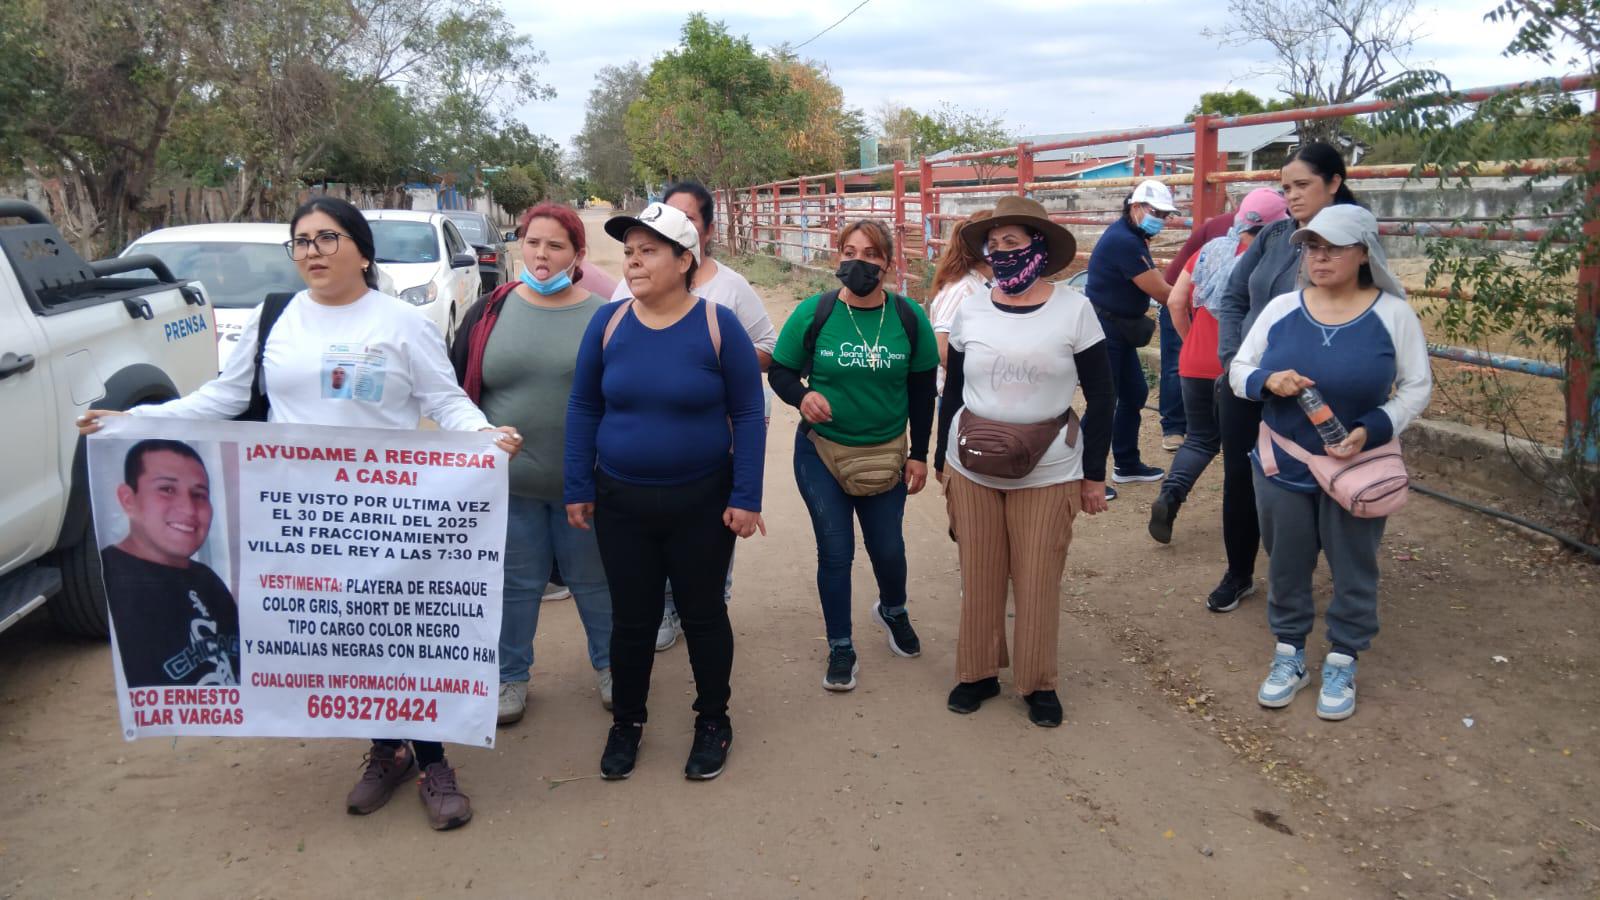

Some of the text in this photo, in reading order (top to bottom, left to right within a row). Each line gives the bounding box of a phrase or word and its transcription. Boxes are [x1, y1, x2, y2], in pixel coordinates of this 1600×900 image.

[164, 314, 207, 342] PRENSA
[246, 444, 495, 469] ¡AYUDAME A REGRESAR
[335, 467, 418, 486] A CASA!
[260, 491, 491, 513] FUE VISTO POR ULTIMA VEZ
[272, 508, 478, 528] EL 30 DE ABRIL DEL 2025
[281, 526, 468, 544] EN FRACCIONAMIENTO
[248, 540, 499, 562] VILLAS DEL REY A LAS 7:30 PM
[259, 574, 487, 597] VESTIMENTA: PLAYERA DE RESAQUE
[262, 597, 484, 618] COLOR GRIS, SHORT DE MEZCLILLA
[288, 619, 460, 638] TIPO CARGO COLOR NEGRO
[245, 639, 496, 664] Y SANDALIAS NEGRAS CON BLANCO H&M
[251, 672, 488, 697] CUALQUIER INFORMACIÓN LLAMAR AL:
[164, 688, 240, 705] ERNESTO
[178, 708, 244, 725] VARGAS
[307, 695, 438, 722] 6693278424
